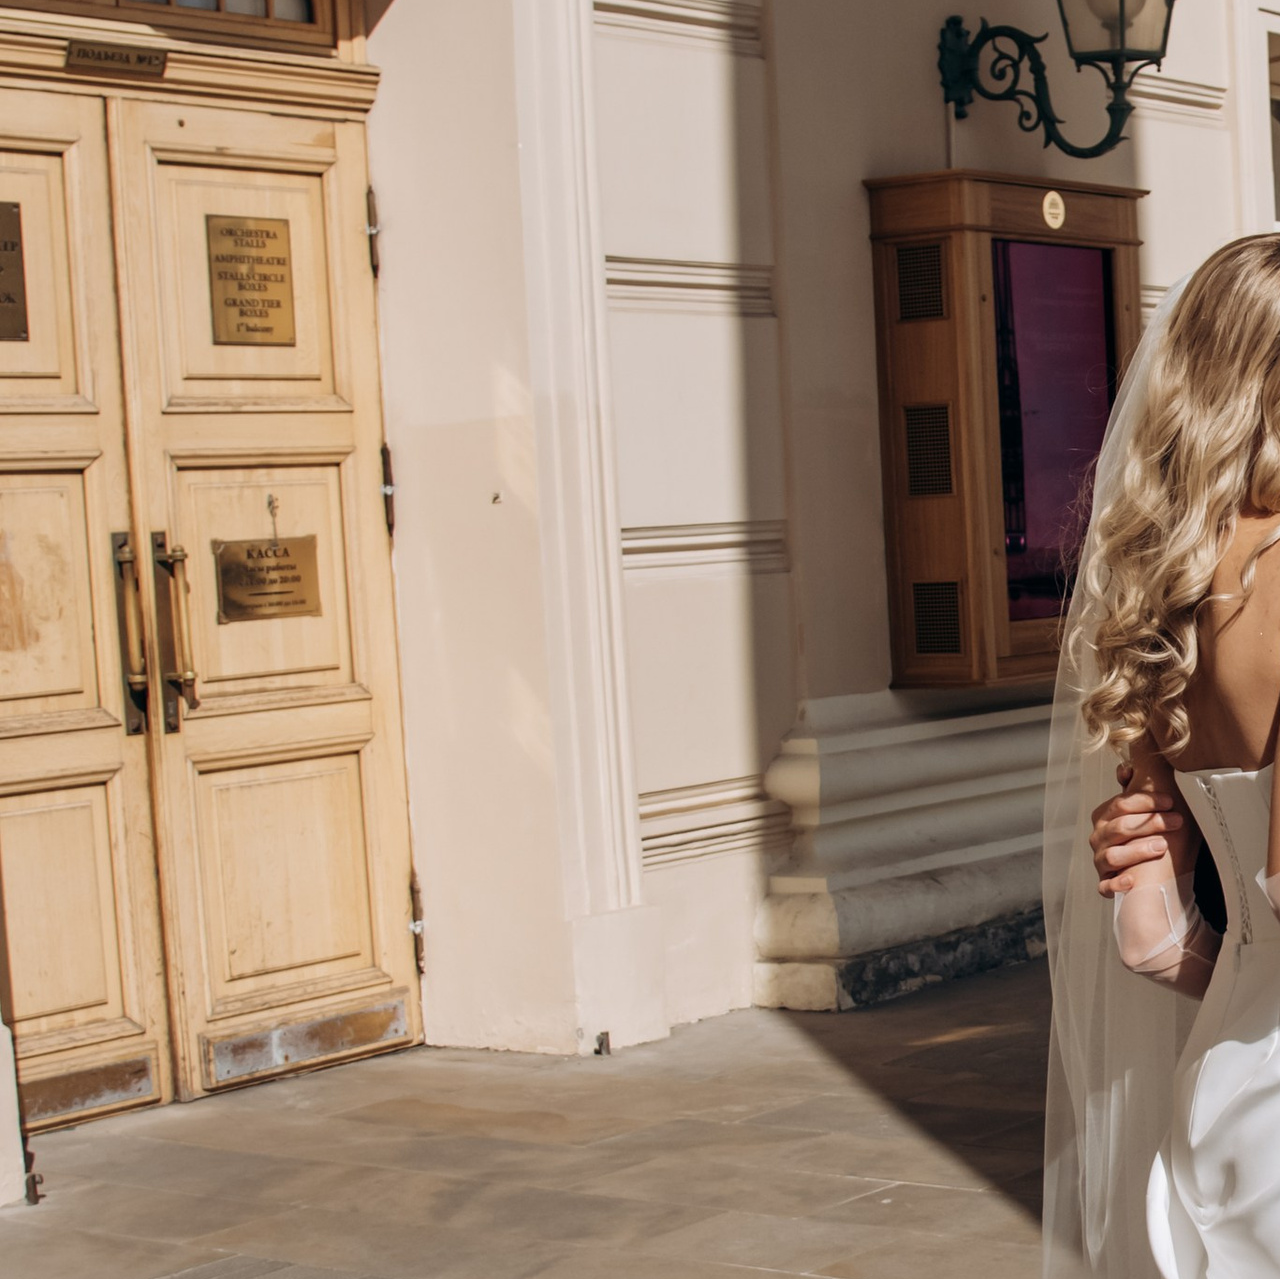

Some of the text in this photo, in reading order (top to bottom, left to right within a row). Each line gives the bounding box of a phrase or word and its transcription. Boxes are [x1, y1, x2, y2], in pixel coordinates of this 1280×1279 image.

[220, 227, 278, 239] ORCHESTRA
[233, 238, 267, 248] STALLS
[214, 254, 287, 266] AMPHITHEATRE
[217, 271, 285, 283] STALLS CIRCLE
[238, 282, 268, 292] BOXES
[224, 297, 282, 309] GRAND TIER
[239, 308, 269, 319] BOXES
[246, 547, 290, 560] КАССА
